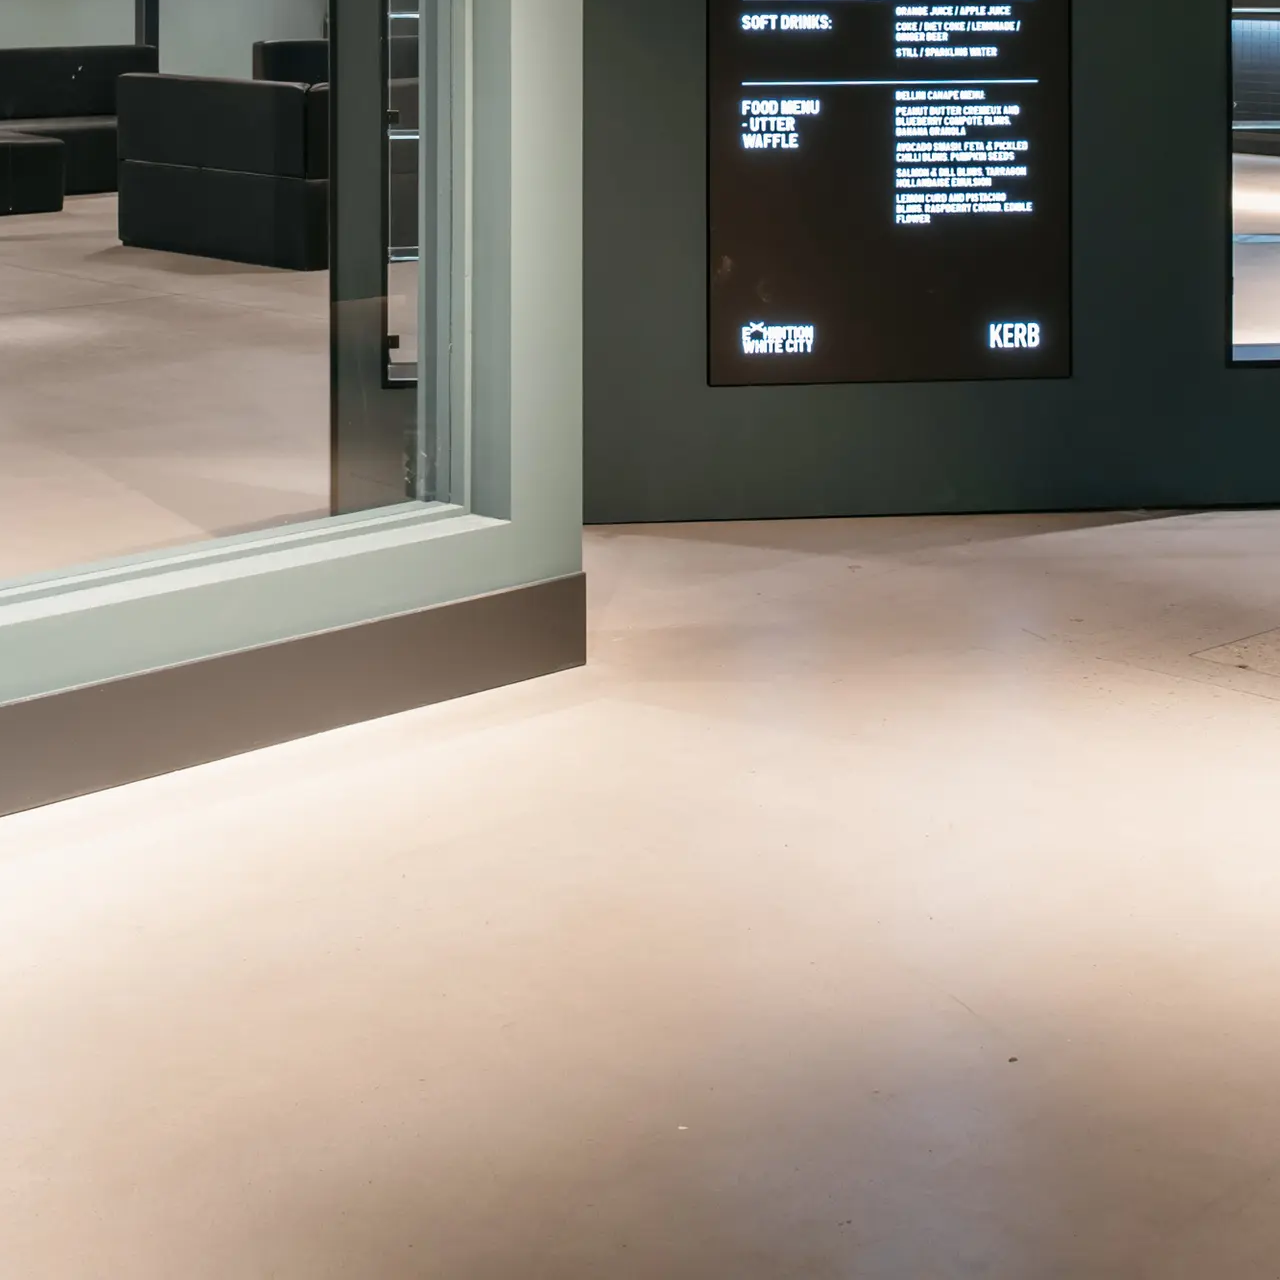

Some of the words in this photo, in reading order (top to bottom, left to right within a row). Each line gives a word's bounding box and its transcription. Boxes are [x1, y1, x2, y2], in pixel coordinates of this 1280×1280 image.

[742, 15, 778, 30] SOFT
[781, 15, 832, 30] DRINKS:
[742, 100, 778, 115] FOOD
[781, 100, 820, 115] MENU
[750, 117, 795, 131] UTTER
[742, 134, 799, 148] WAFFLE
[990, 323, 1040, 347] KERB
[743, 340, 783, 353] WHITE
[785, 340, 812, 353] CITY
